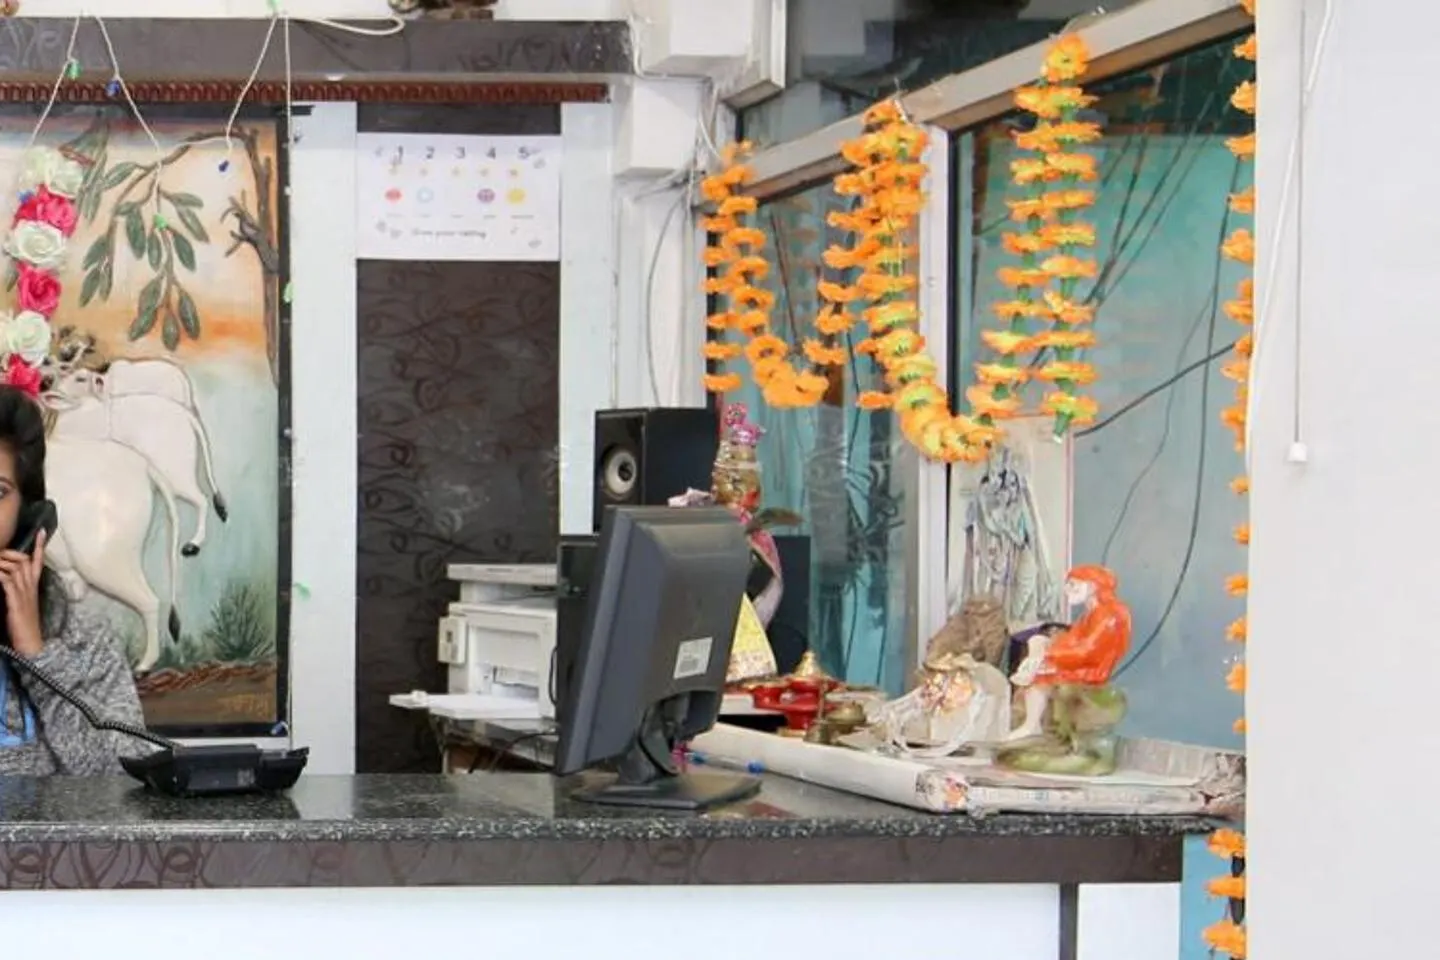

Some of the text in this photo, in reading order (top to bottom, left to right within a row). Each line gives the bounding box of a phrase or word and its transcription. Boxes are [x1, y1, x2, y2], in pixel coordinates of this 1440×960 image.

[425, 146, 435, 159] 2
[456, 146, 465, 159] 3
[486, 146, 496, 159] 4
[518, 146, 530, 159] 5
